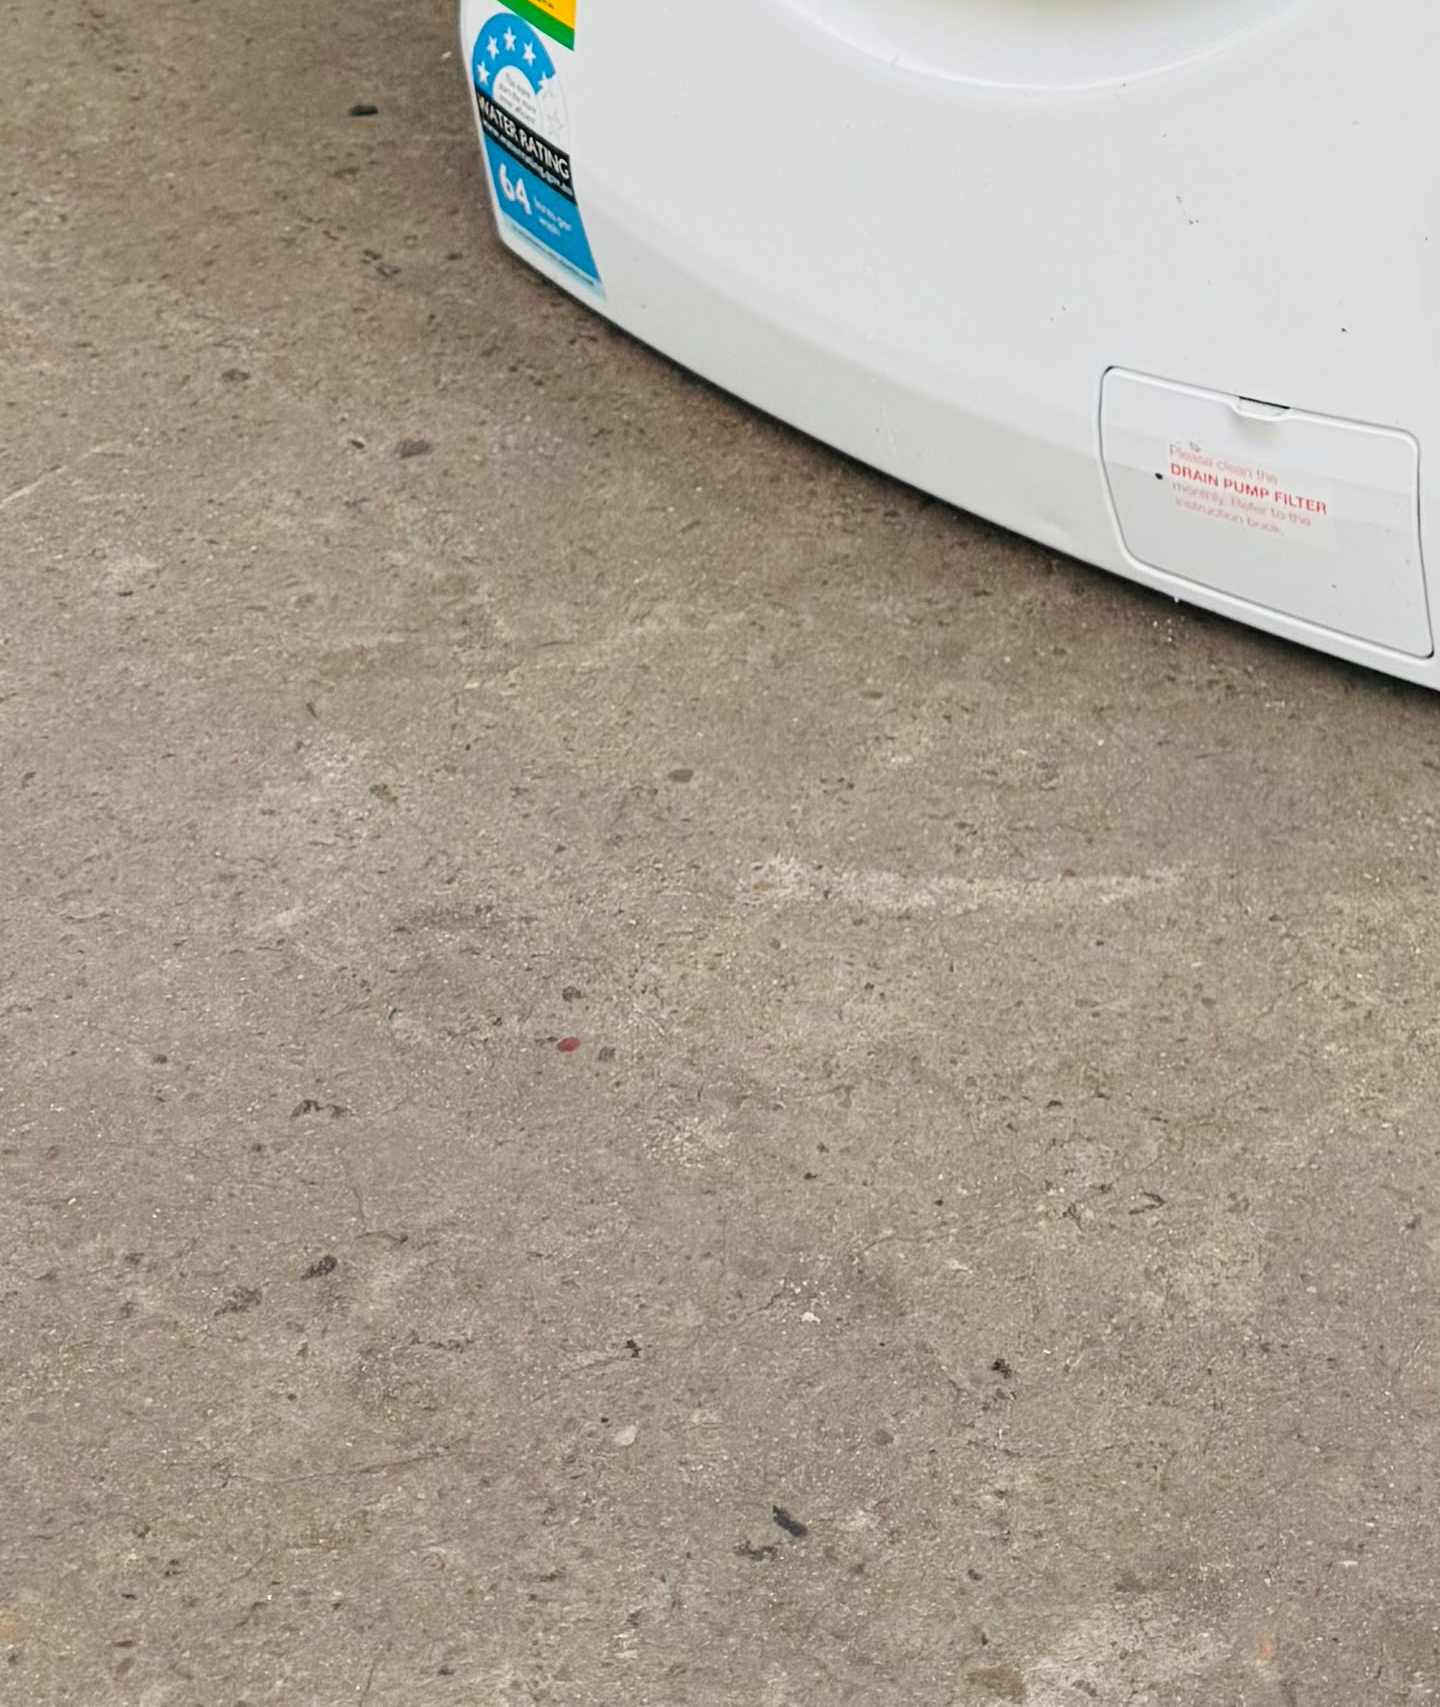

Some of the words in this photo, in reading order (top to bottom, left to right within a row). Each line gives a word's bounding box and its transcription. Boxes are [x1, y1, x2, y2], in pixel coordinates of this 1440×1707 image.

[476, 91, 519, 142] WATER
[518, 128, 570, 180] RATING
[499, 163, 532, 215] 64
[1169, 443, 1214, 468] Please
[1216, 460, 1253, 478] clean
[1256, 467, 1279, 485] the
[1171, 462, 1219, 486] DRAIN
[1223, 478, 1270, 499] PUMP
[1274, 491, 1327, 516] FILTER
[1231, 495, 1266, 514] Refer
[1270, 507, 1286, 521] to
[1288, 512, 1311, 527] the
